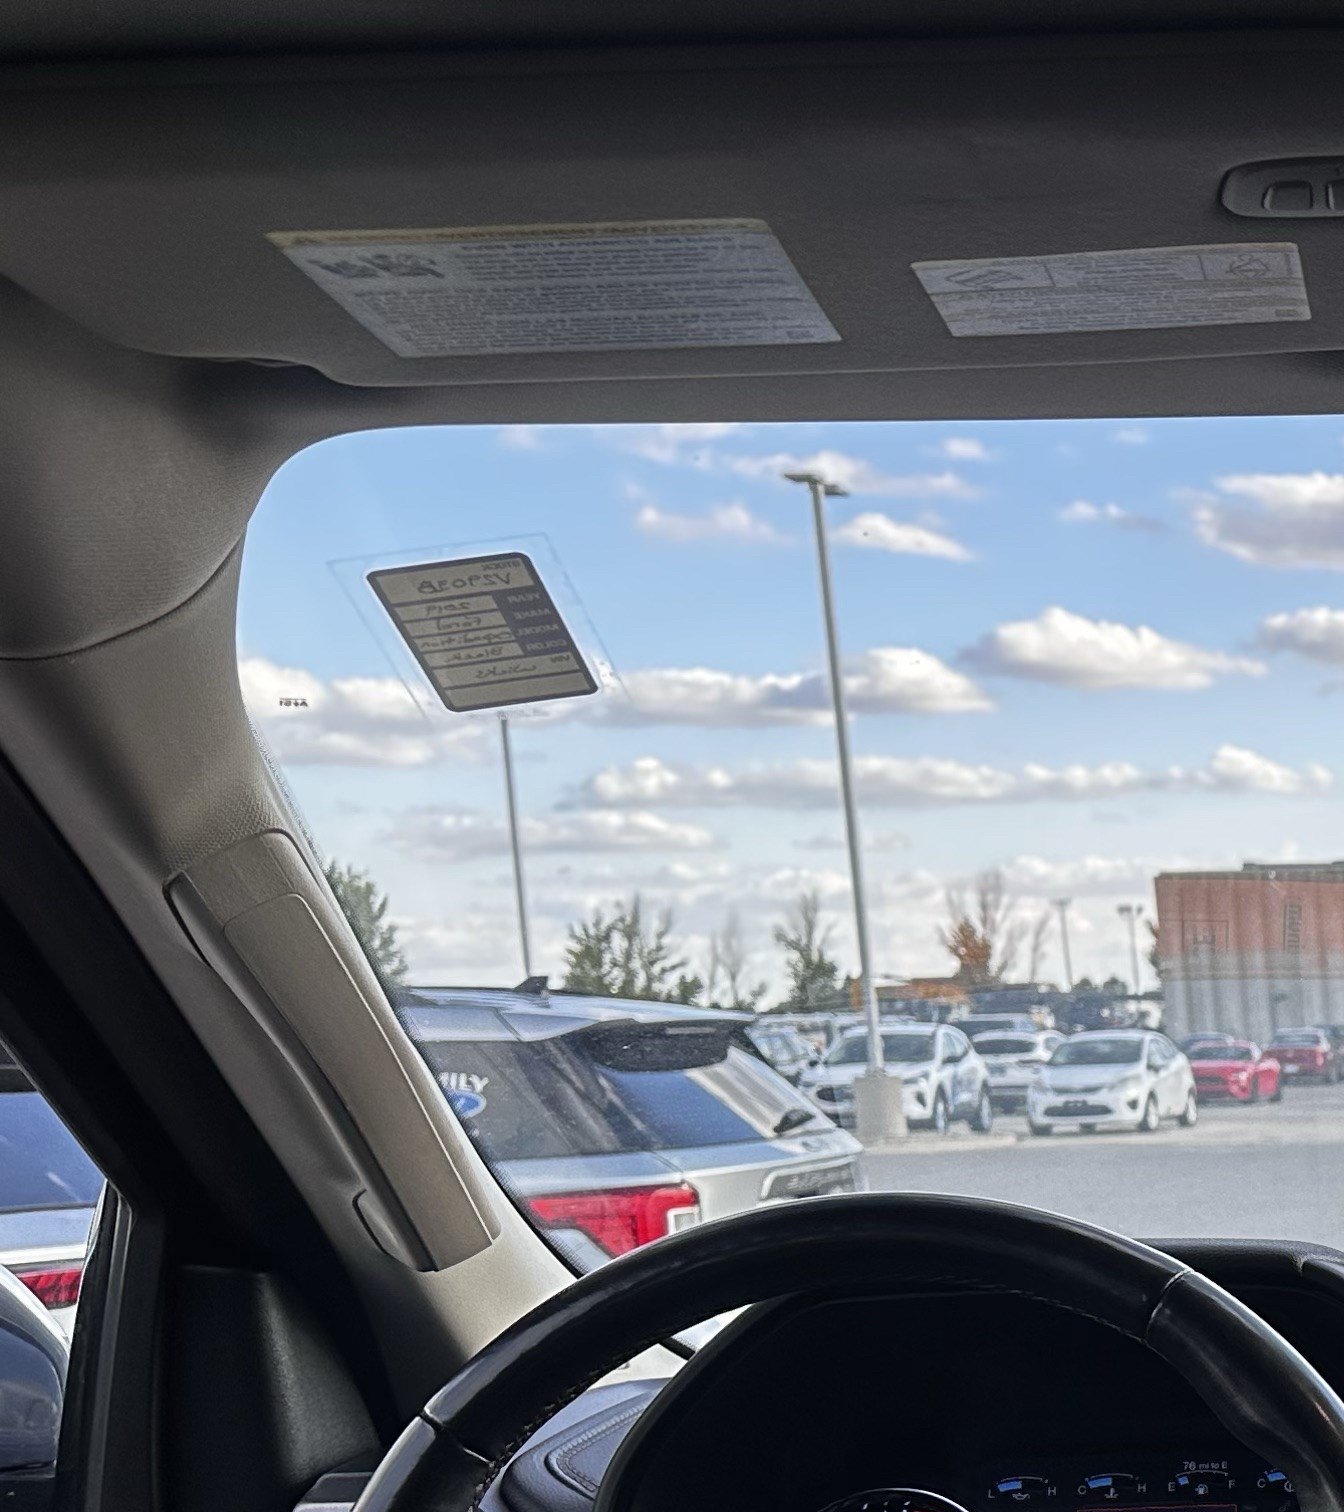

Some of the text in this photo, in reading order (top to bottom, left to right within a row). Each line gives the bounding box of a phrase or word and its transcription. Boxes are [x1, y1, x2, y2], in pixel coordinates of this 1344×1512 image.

[1168, 1482, 1175, 1492] E
[1228, 1479, 1236, 1489] F
[1257, 1478, 1267, 1488] C
[1077, 1485, 1087, 1495] C
